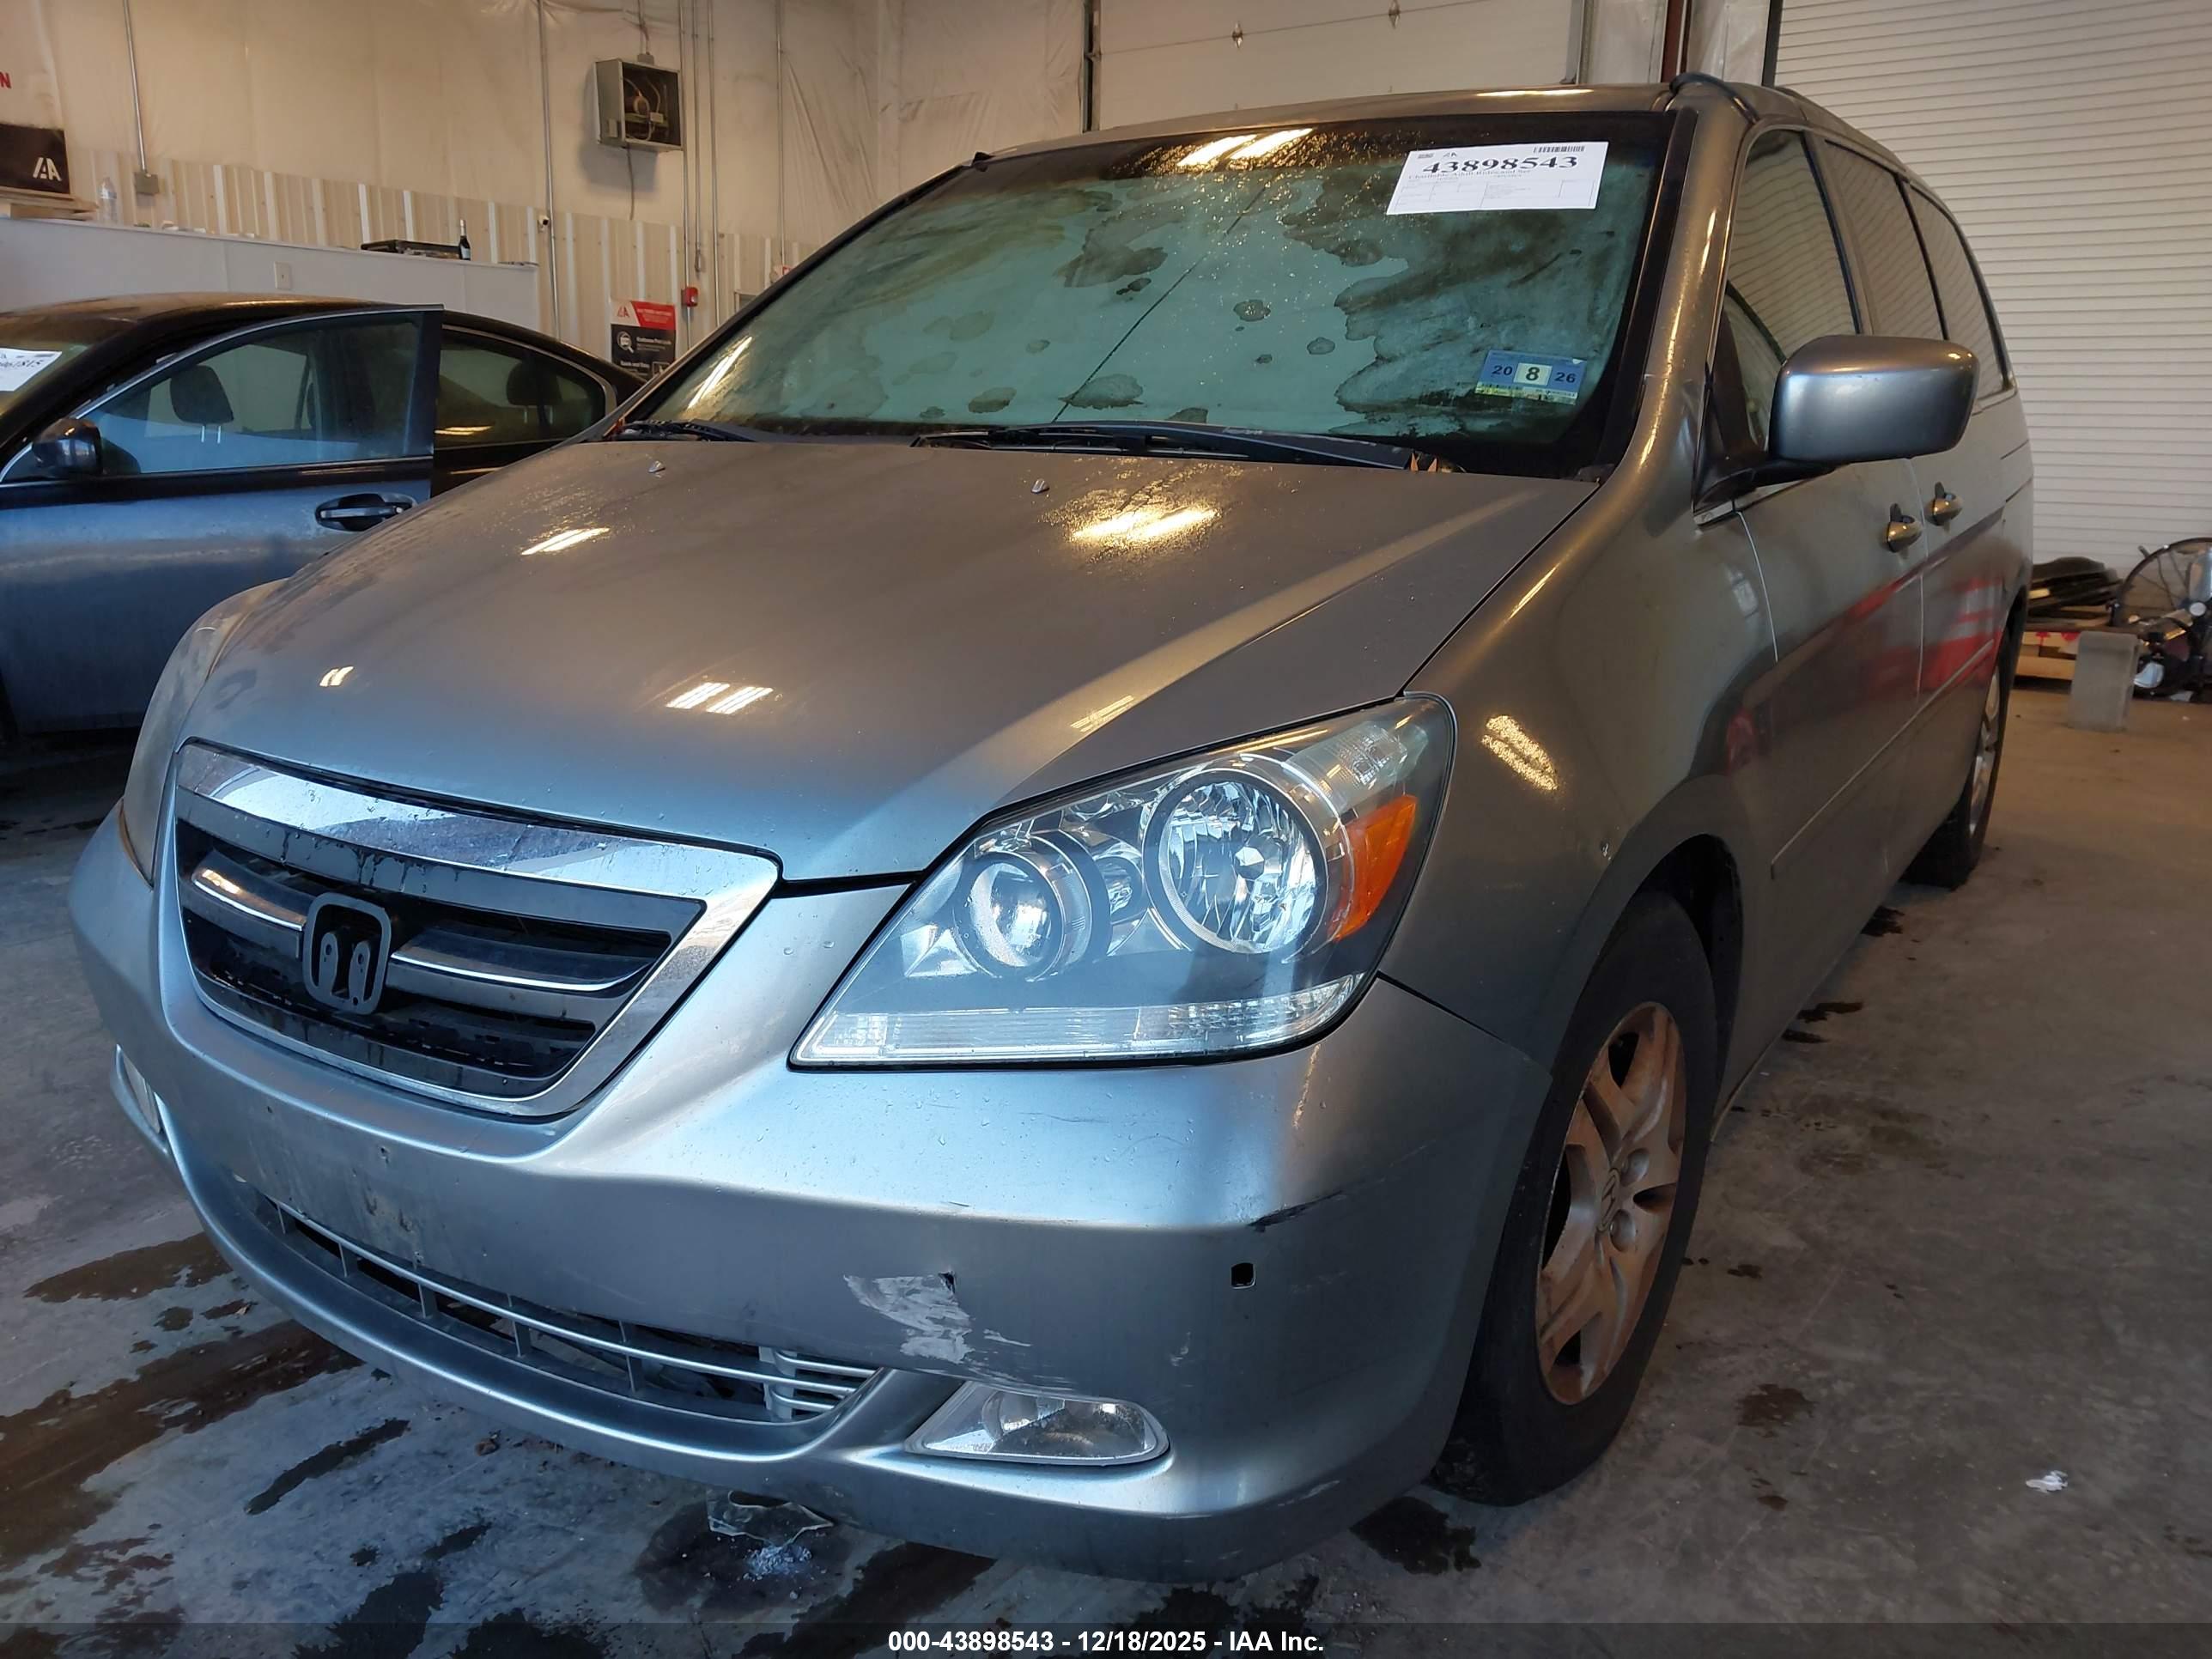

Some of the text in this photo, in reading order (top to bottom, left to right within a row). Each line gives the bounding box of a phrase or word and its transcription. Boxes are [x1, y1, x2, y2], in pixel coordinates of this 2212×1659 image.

[1423, 156, 1577, 173] 43898543
[1492, 365, 1576, 383] 20 8 26
